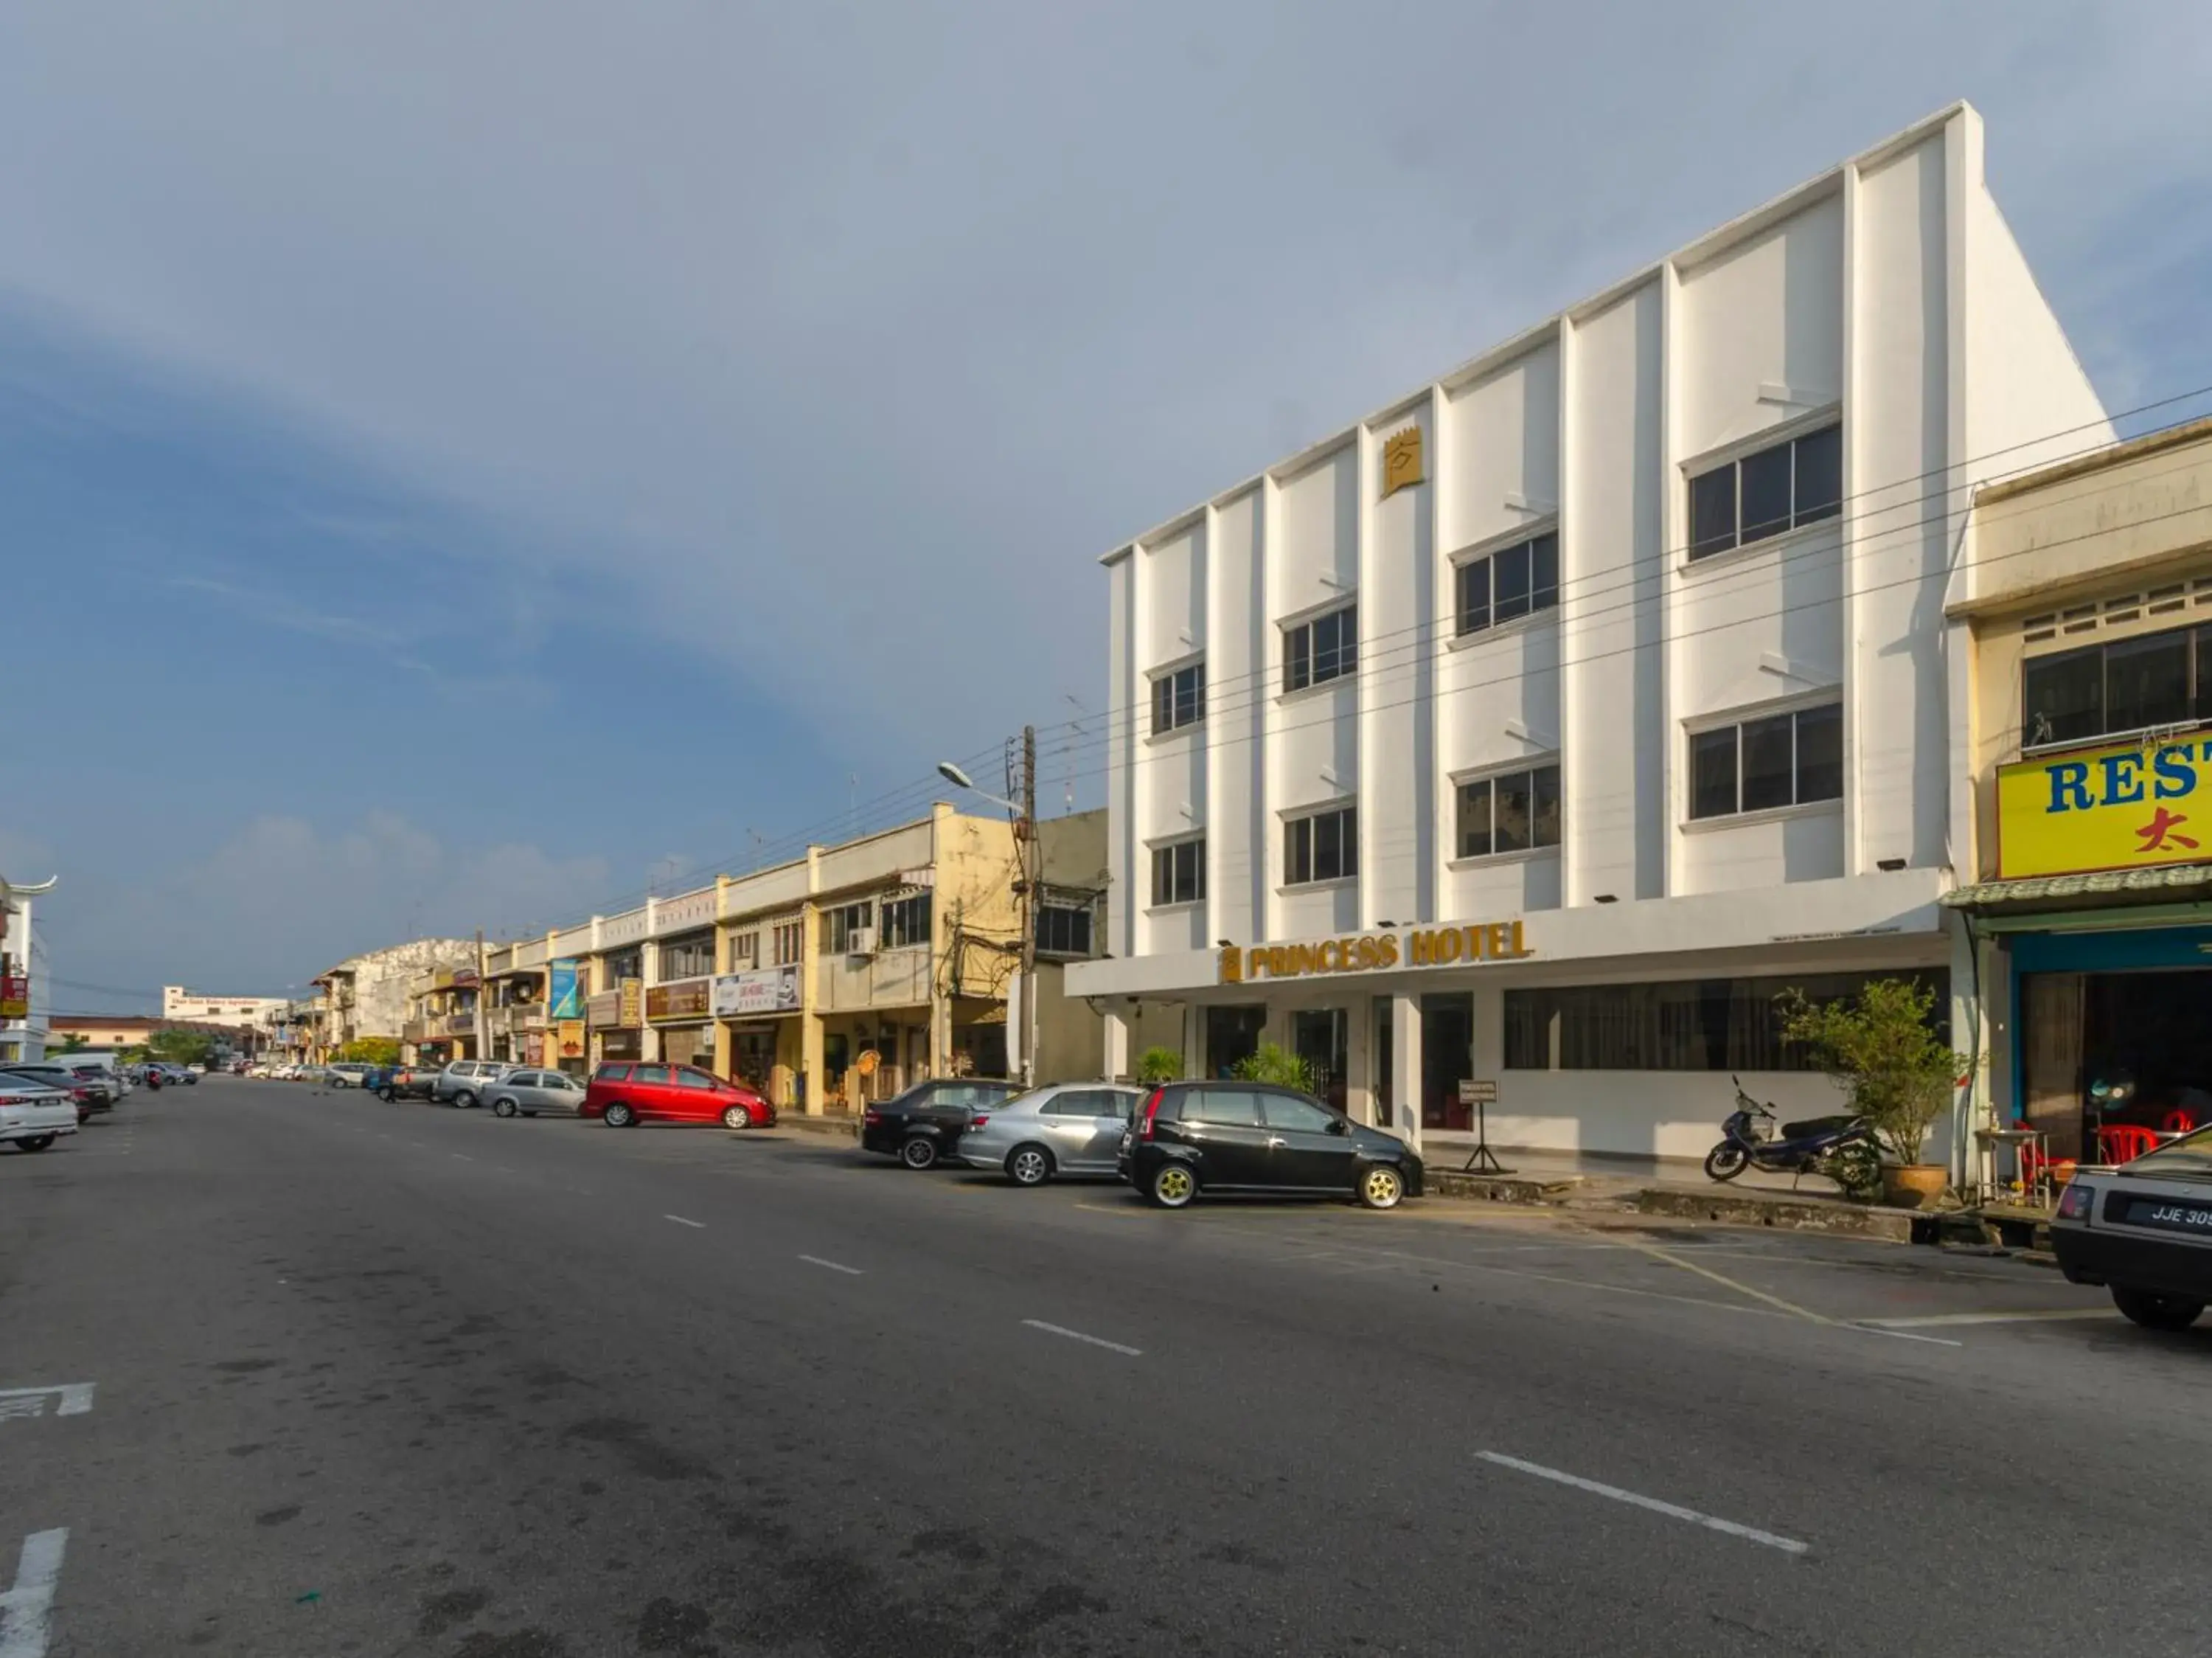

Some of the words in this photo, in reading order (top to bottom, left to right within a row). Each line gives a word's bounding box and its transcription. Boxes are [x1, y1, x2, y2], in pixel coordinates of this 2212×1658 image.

[2045, 741, 2212, 814] RES
[2135, 806, 2199, 853] 太
[1248, 933, 1399, 978] PRINCESS
[1408, 920, 1534, 966] HOTEL
[2152, 1206, 2183, 1222] JJE
